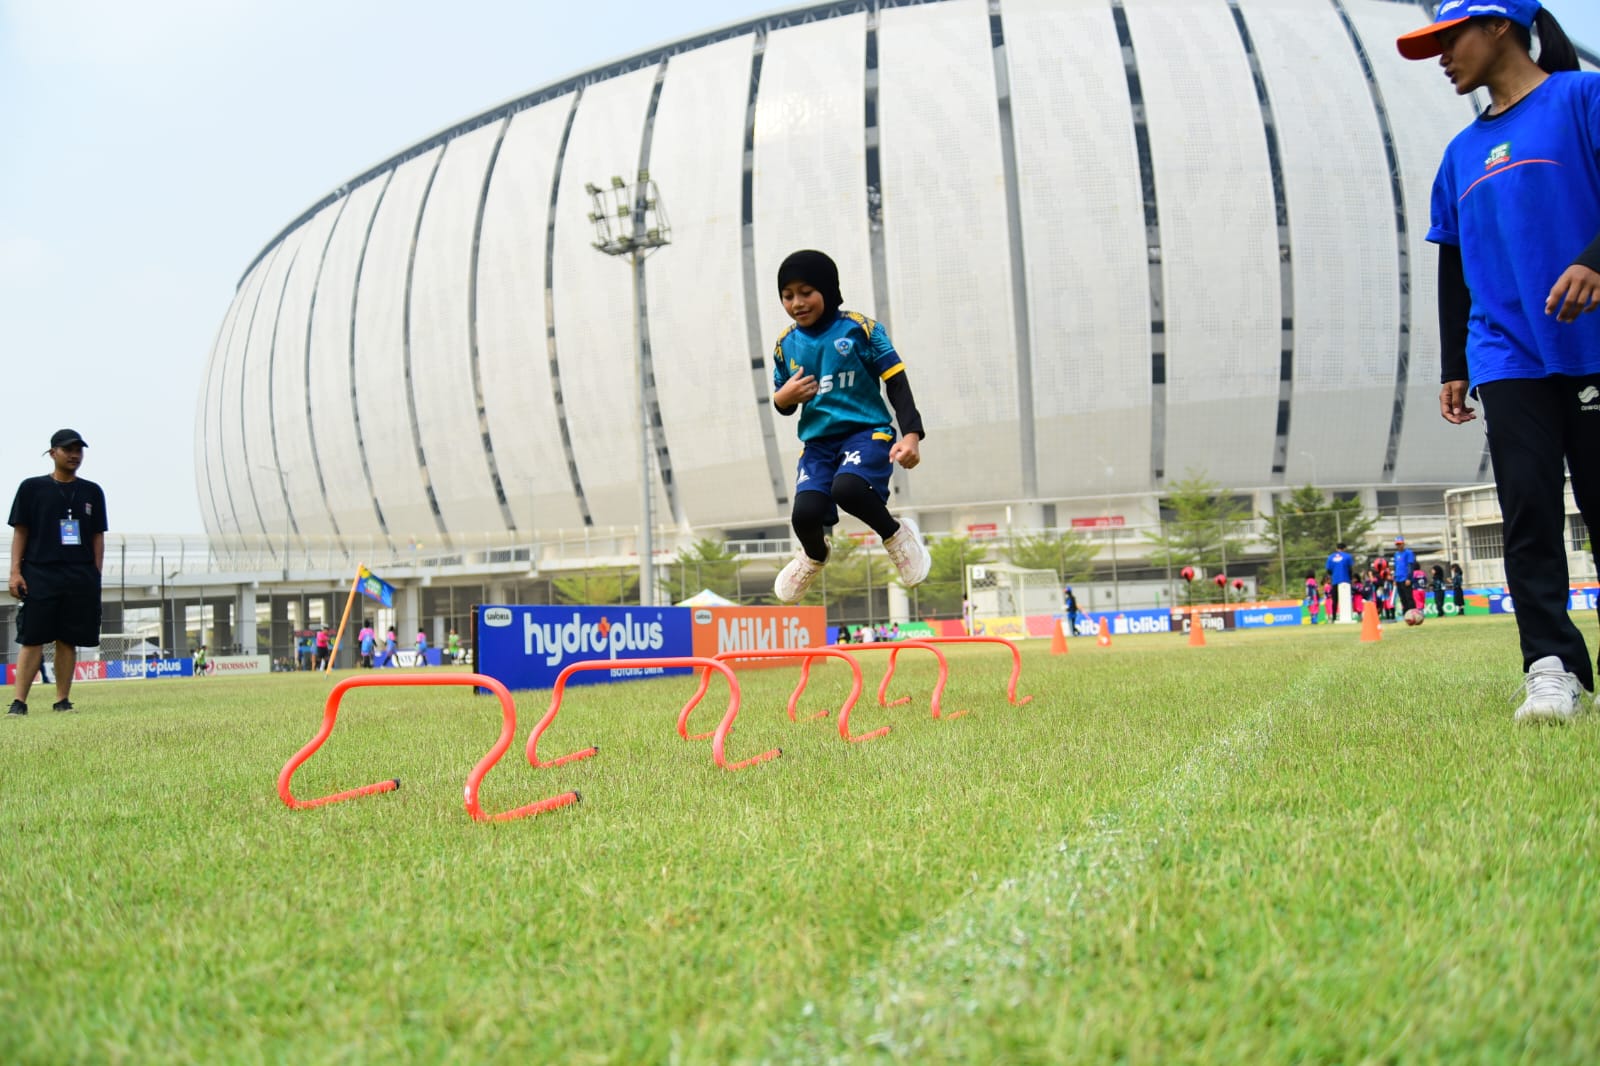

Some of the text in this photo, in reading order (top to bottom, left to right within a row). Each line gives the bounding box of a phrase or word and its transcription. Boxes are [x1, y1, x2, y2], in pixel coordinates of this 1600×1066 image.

[838, 371, 855, 388] 11
[842, 450, 861, 465] 14
[1129, 615, 1170, 633] blibli
[523, 612, 663, 667] hydroplus
[718, 616, 810, 662] MilkLife
[122, 660, 182, 675] hydroplus
[216, 661, 259, 671] CROISSANT
